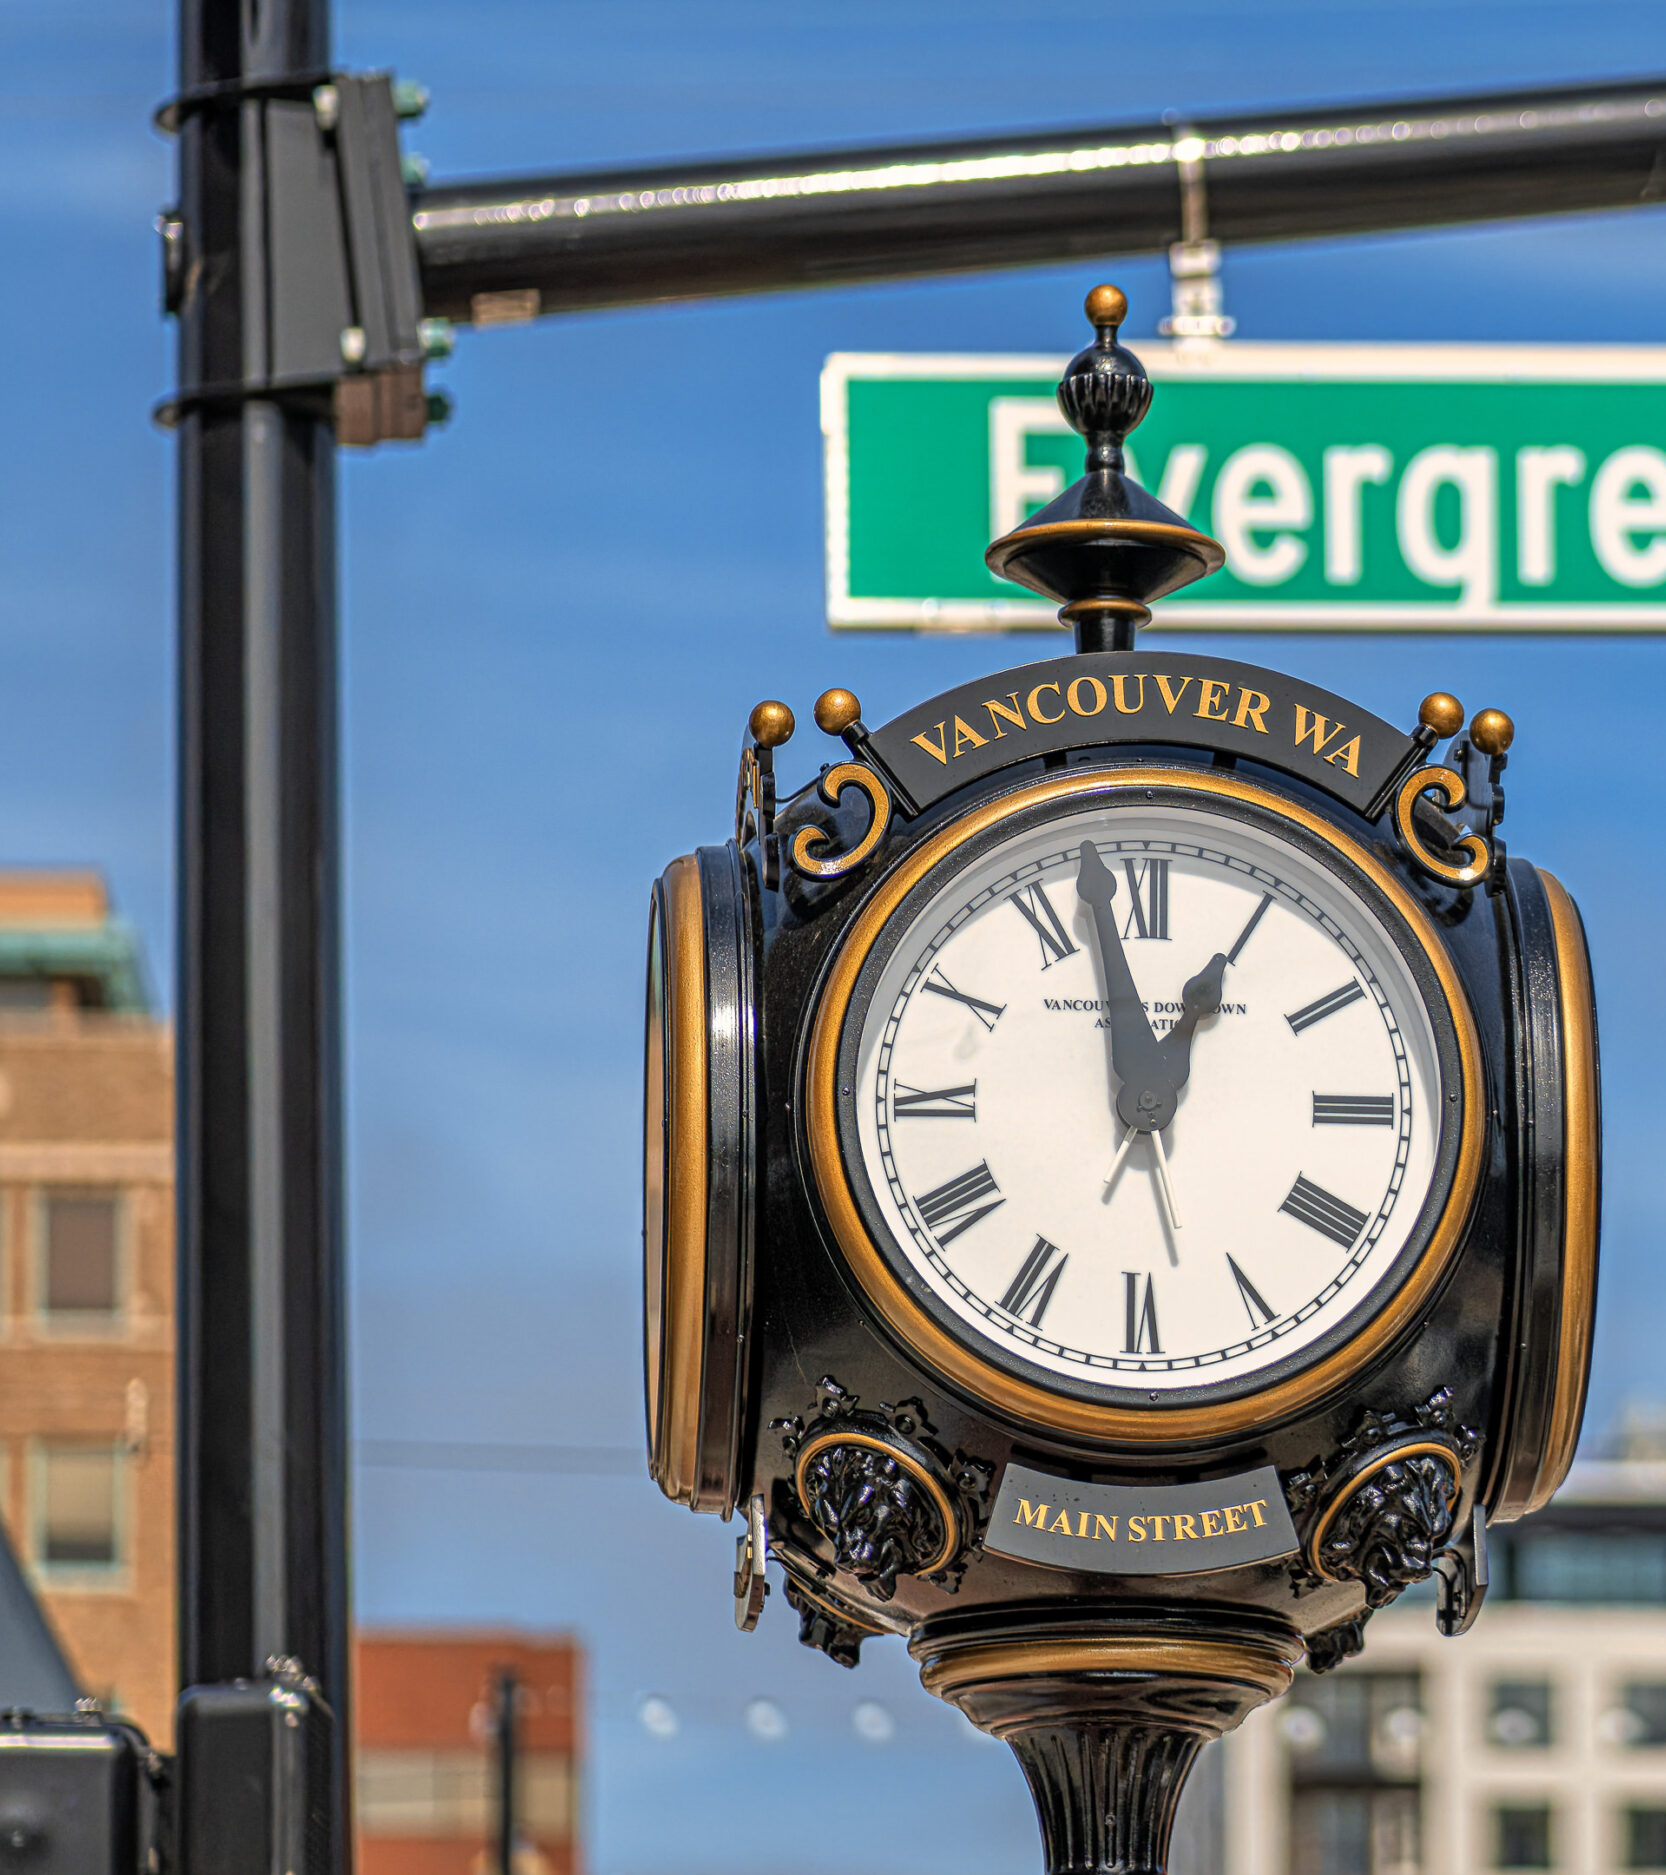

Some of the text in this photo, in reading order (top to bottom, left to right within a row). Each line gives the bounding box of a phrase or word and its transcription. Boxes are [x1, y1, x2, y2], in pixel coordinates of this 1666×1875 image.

[910, 673, 1363, 779] VANCOUVER WA
[1003, 878, 1081, 971] XI
[1120, 857, 1173, 941] XII
[920, 962, 1007, 1032] X
[1283, 976, 1368, 1037] II
[894, 1078, 977, 1123] IX
[1311, 1090, 1394, 1130] III
[912, 1158, 1007, 1252] VIII
[1277, 1170, 1372, 1254] IIII
[994, 1233, 1069, 1332] VII
[1119, 1271, 1166, 1354] VI
[1226, 1251, 1281, 1331] V
[1012, 1498, 1268, 1542] MAIN STREET
